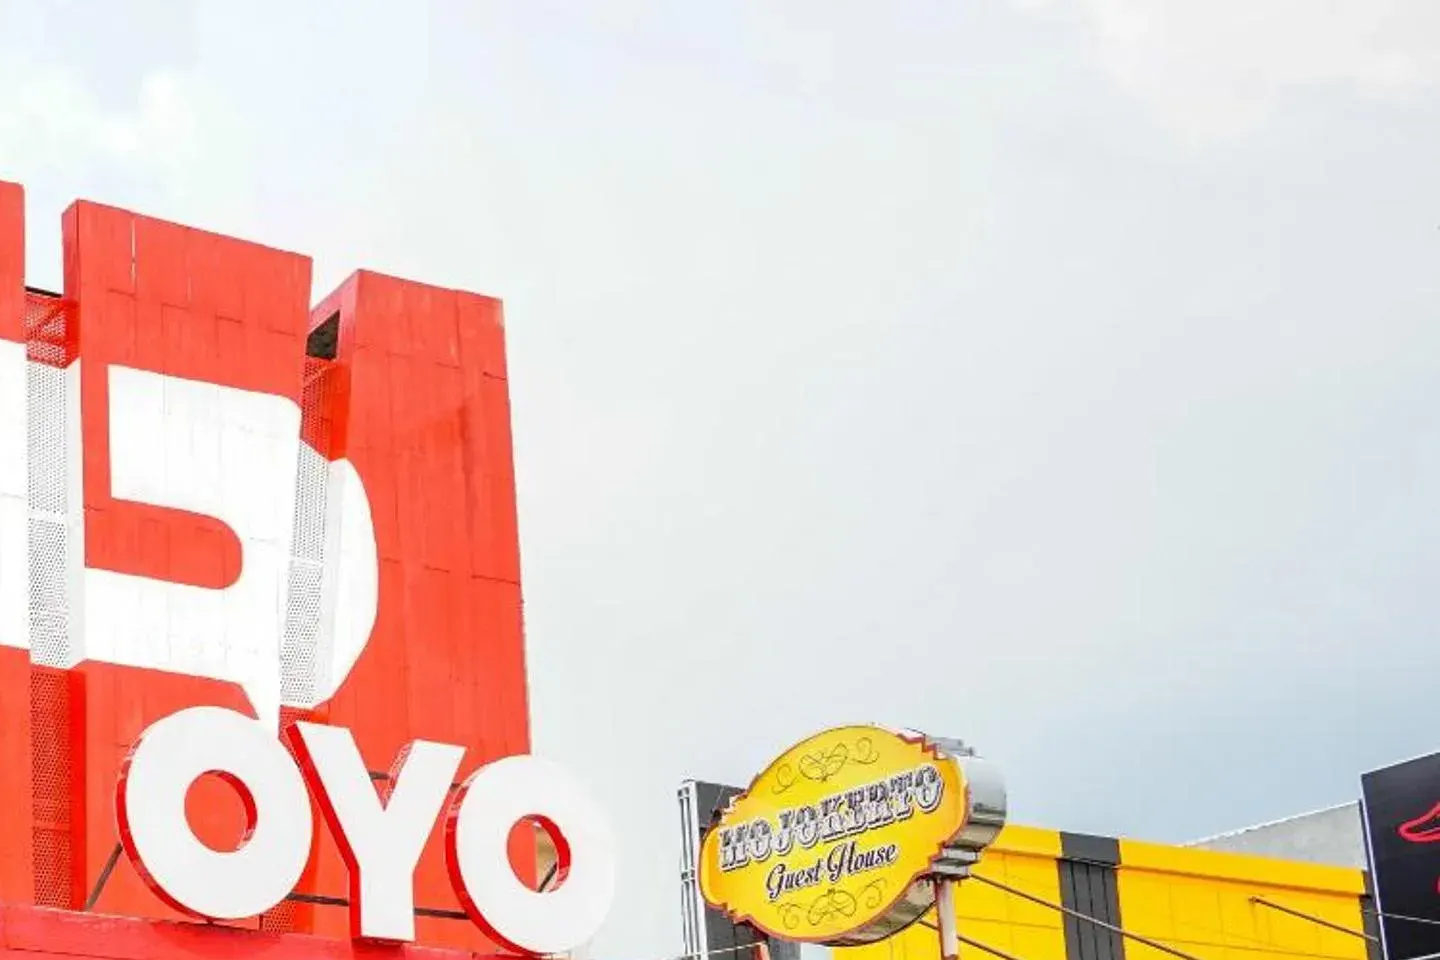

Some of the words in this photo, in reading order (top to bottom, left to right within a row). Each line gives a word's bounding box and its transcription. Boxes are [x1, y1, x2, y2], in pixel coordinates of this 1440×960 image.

[116, 705, 616, 957] OYO
[765, 862, 822, 899] Guest
[826, 841, 897, 882] House
